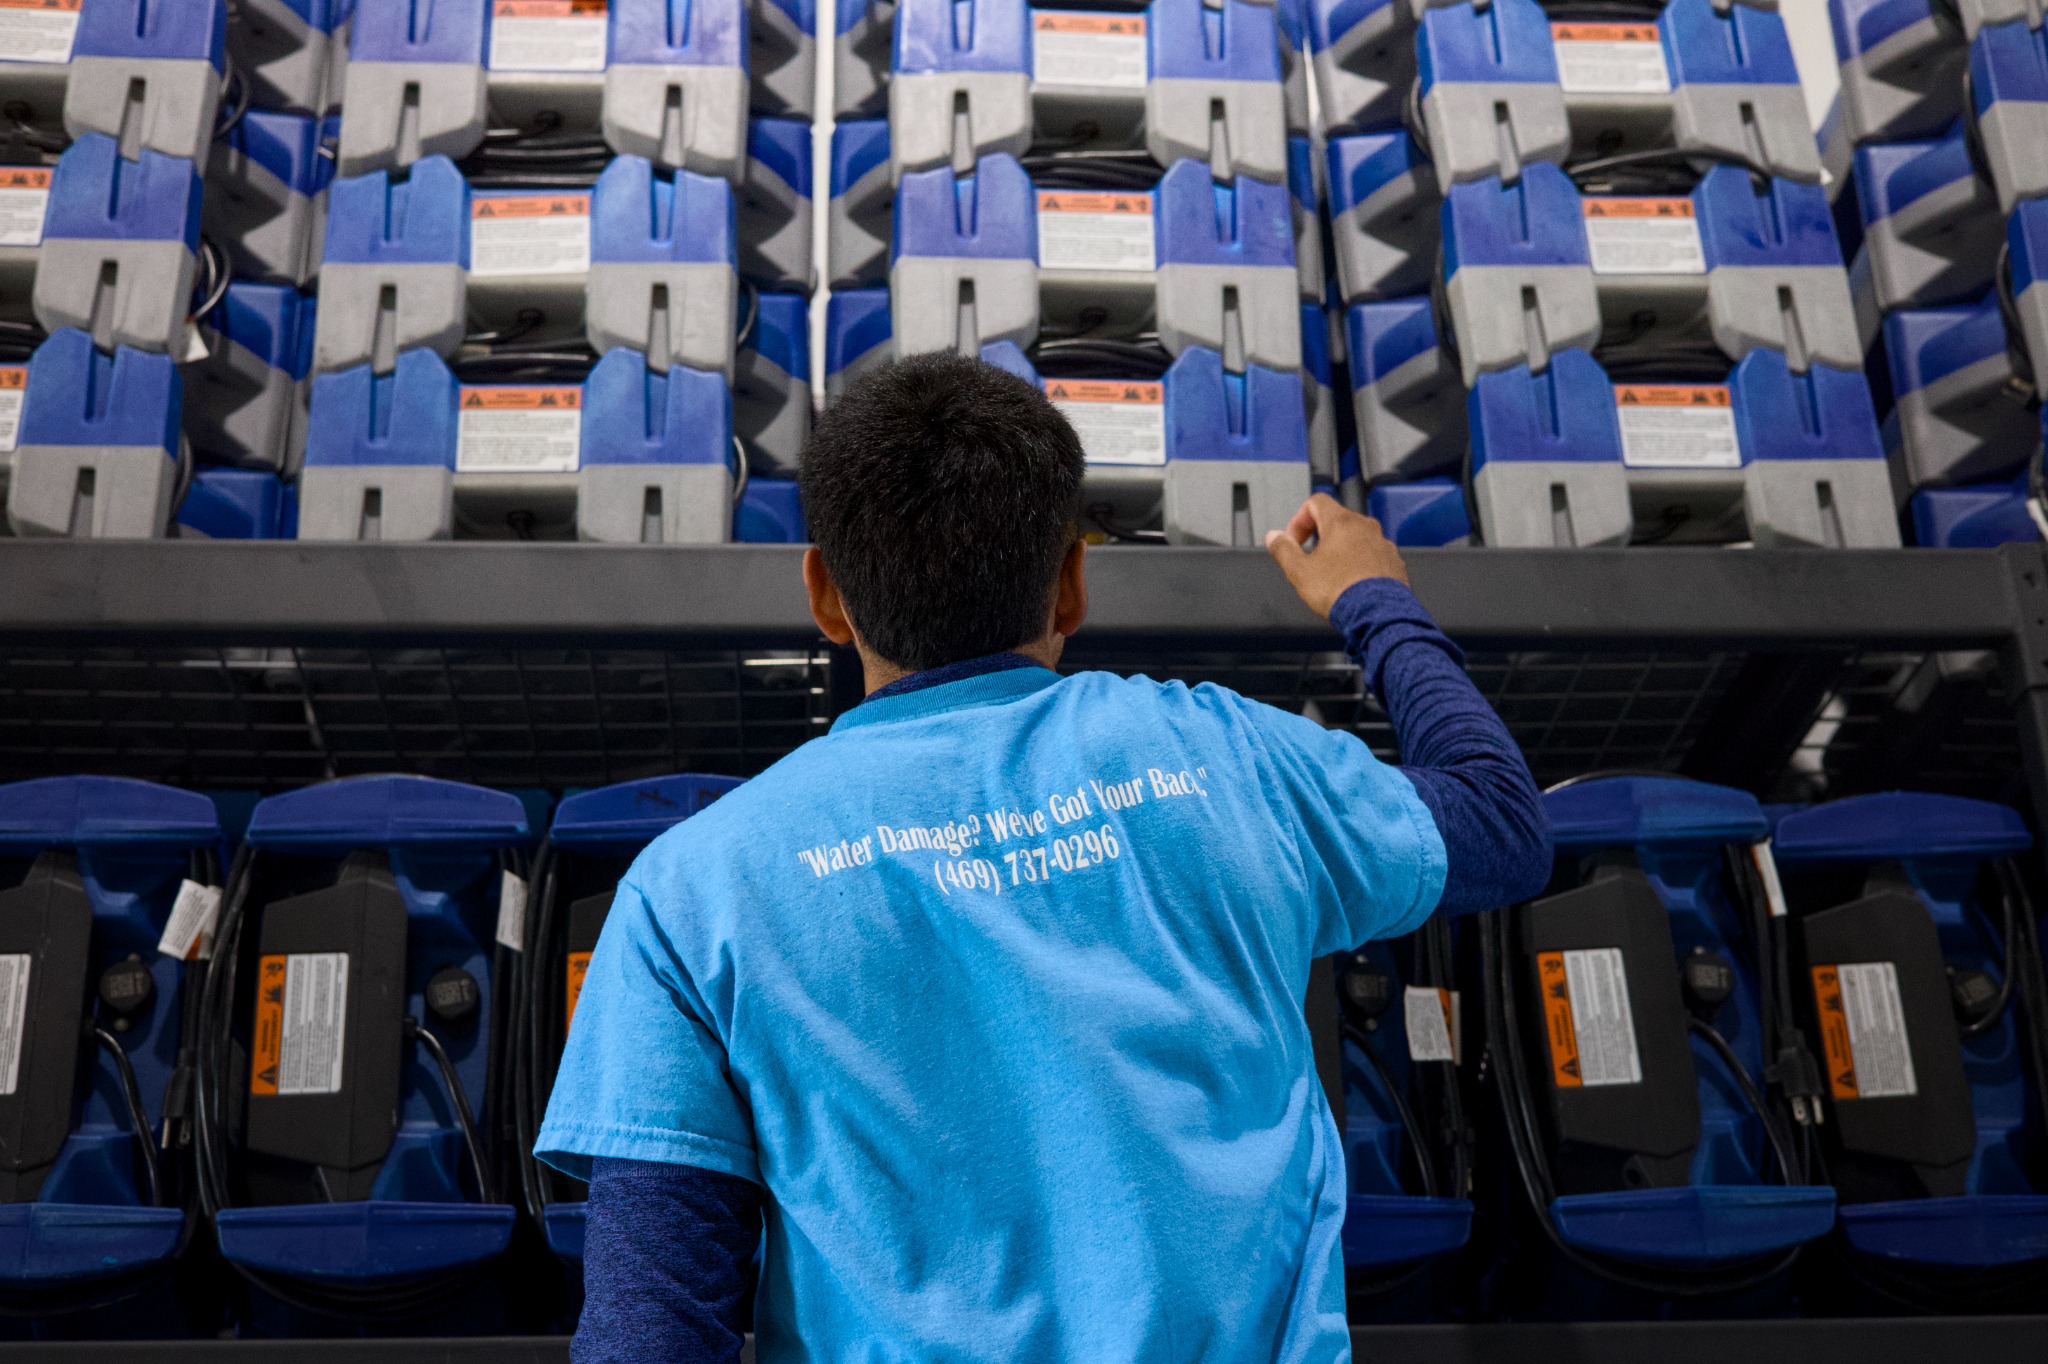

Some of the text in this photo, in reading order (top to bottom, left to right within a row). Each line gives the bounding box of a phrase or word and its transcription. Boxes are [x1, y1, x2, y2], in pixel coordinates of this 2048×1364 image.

[876, 814, 981, 857] Damage?
[1049, 785, 1092, 825] Got
[1089, 777, 1143, 811] Your
[934, 824, 1119, 896] (469) 737-0296
